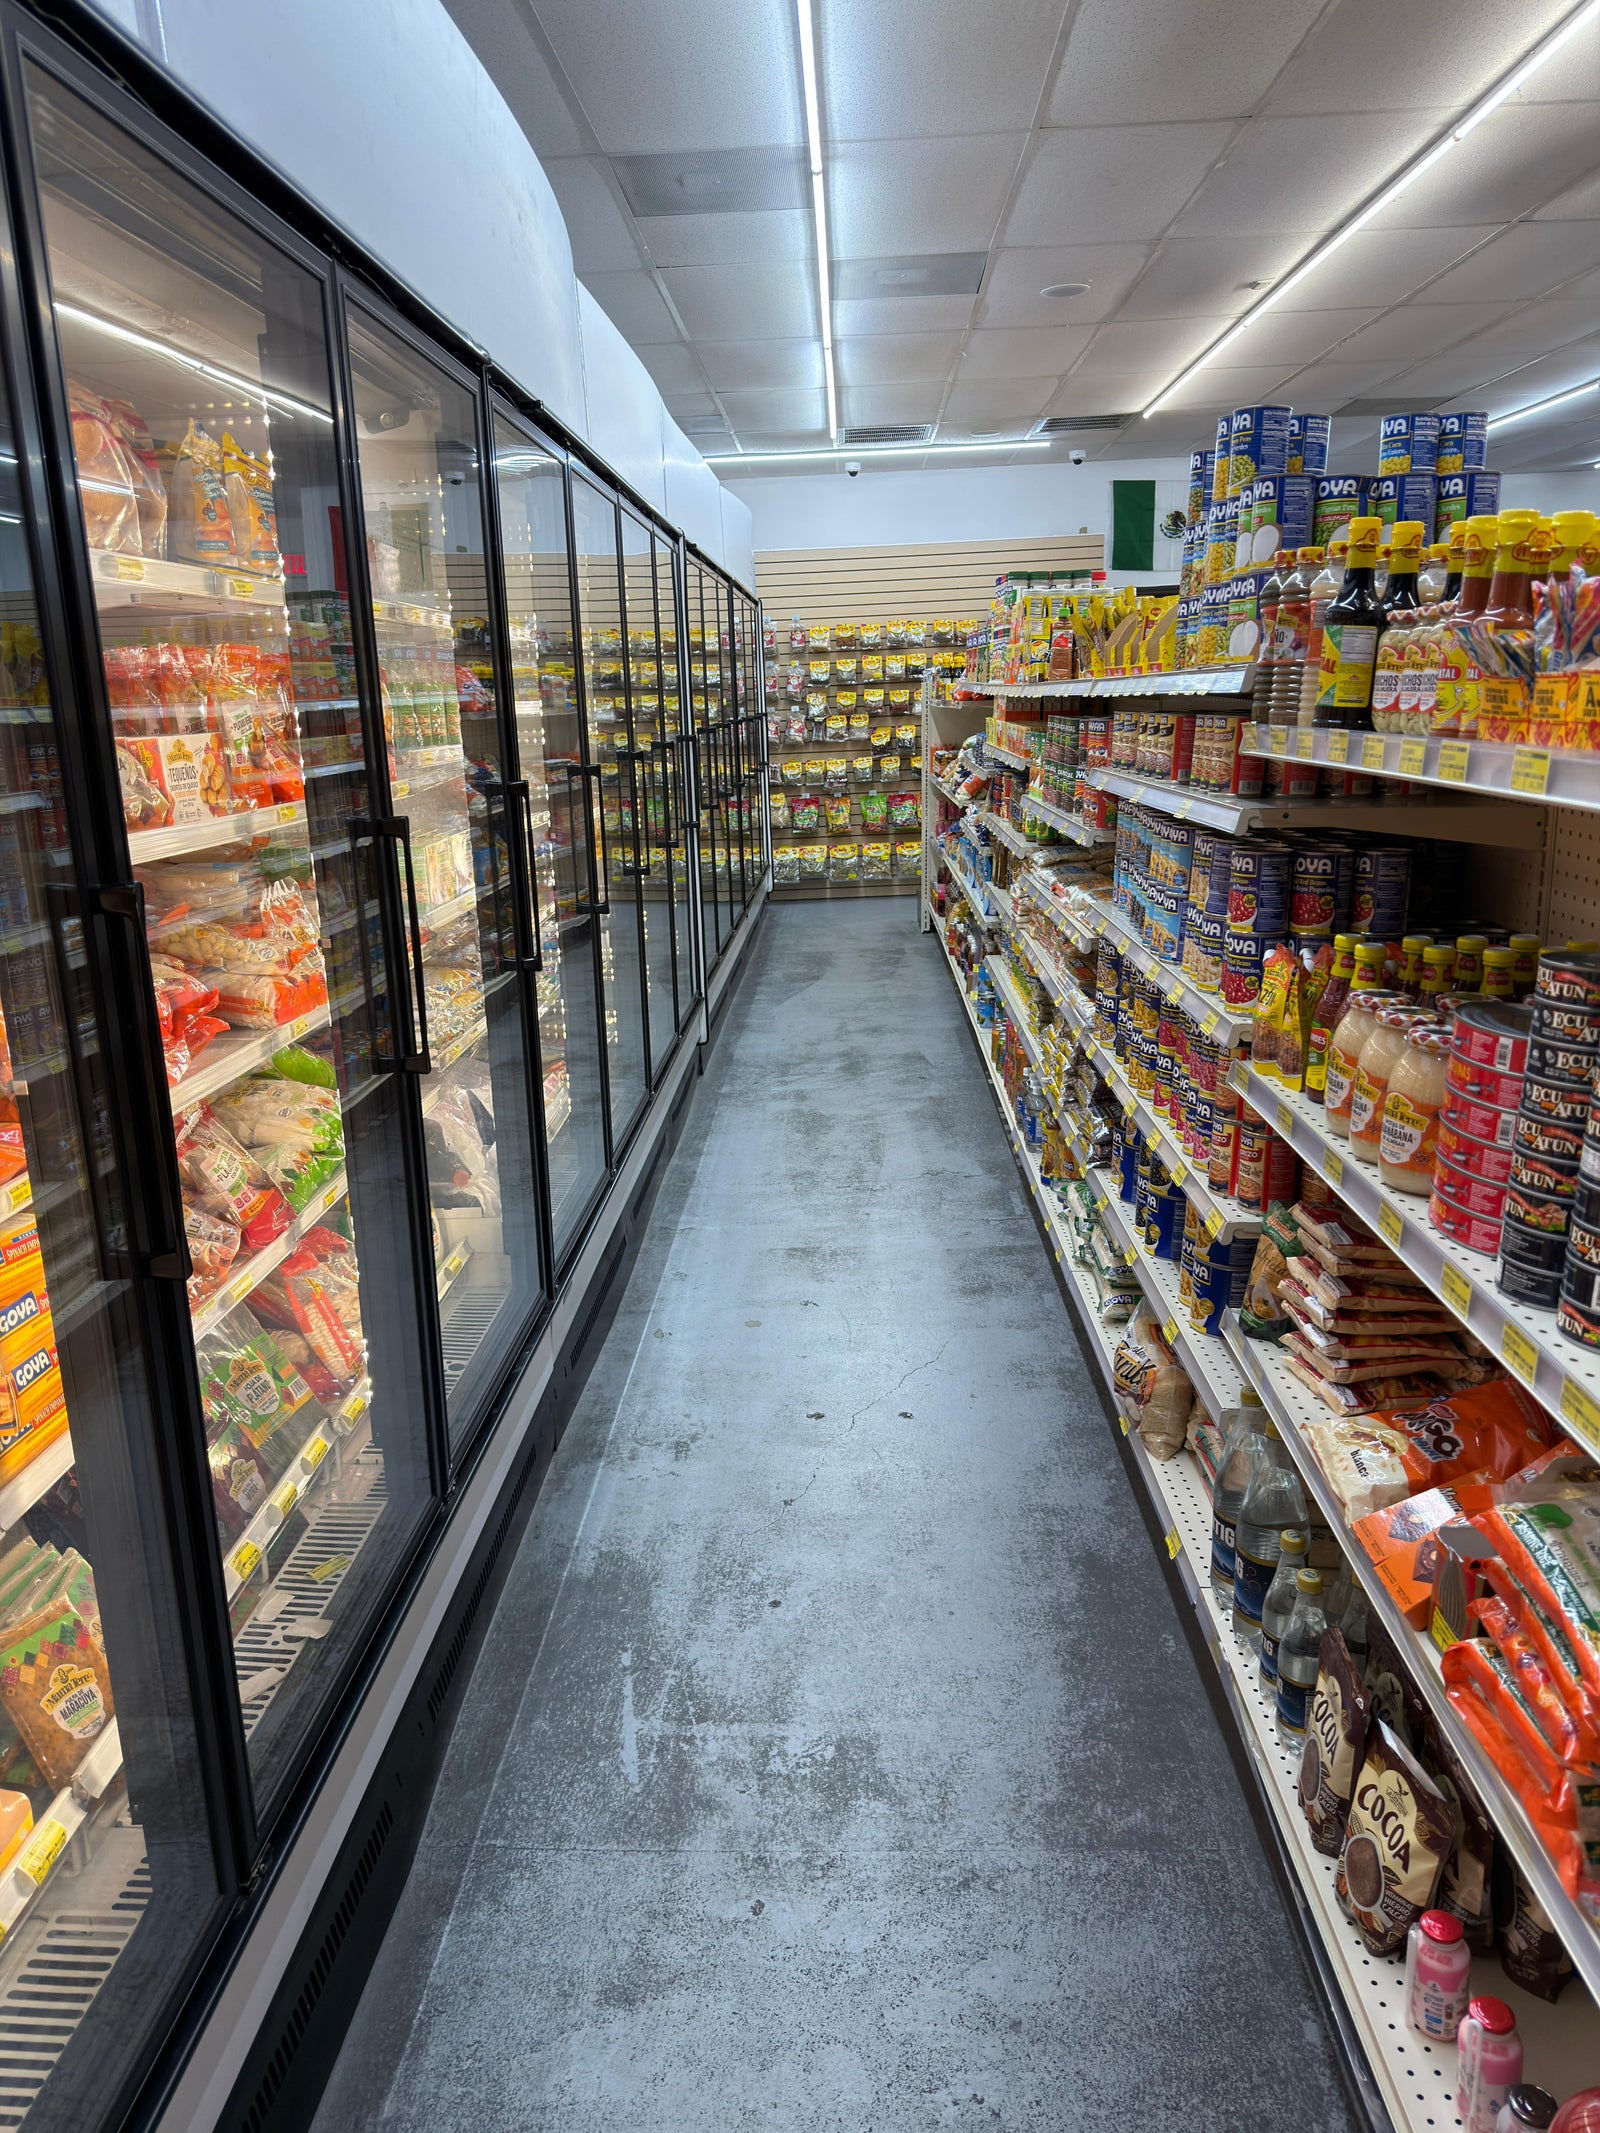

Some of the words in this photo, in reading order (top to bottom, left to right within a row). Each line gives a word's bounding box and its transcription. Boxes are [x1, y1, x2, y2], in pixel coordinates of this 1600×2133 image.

[1233, 413, 1251, 434] YA
[1382, 417, 1407, 437] YA
[1253, 479, 1275, 500] YA
[1318, 478, 1358, 498] OYA
[1440, 477, 1463, 497] YA
[168, 763, 197, 784] TEQUEÑOS
[1296, 856, 1333, 874] OYA
[1203, 920, 1221, 937] YA
[1545, 981, 1587, 1000] ATUN
[1551, 1010, 1589, 1029] ECU
[1556, 1050, 1595, 1069] ECU
[1531, 1084, 1562, 1104] ECU
[1551, 1101, 1590, 1120] ATU
[1518, 1116, 1542, 1138] ECU
[1531, 1133, 1578, 1155] ATUN
[1516, 1167, 1557, 1190] ATUN
[1506, 1198, 1526, 1220] TUN
[1571, 1224, 1596, 1248] ECU
[6, 1243, 27, 1261] SPINACH
[0, 1296, 38, 1331] GOYA
[16, 1350, 50, 1387] GOYA
[46, 1680, 73, 1707] Mama
[72, 1673, 90, 1692] Tere
[59, 1687, 97, 1721] MARACUYÁ
[1312, 1690, 1338, 1767] COCOA
[1357, 1783, 1411, 1876] COCOA
[1383, 1896, 1412, 1917] HIERRO
